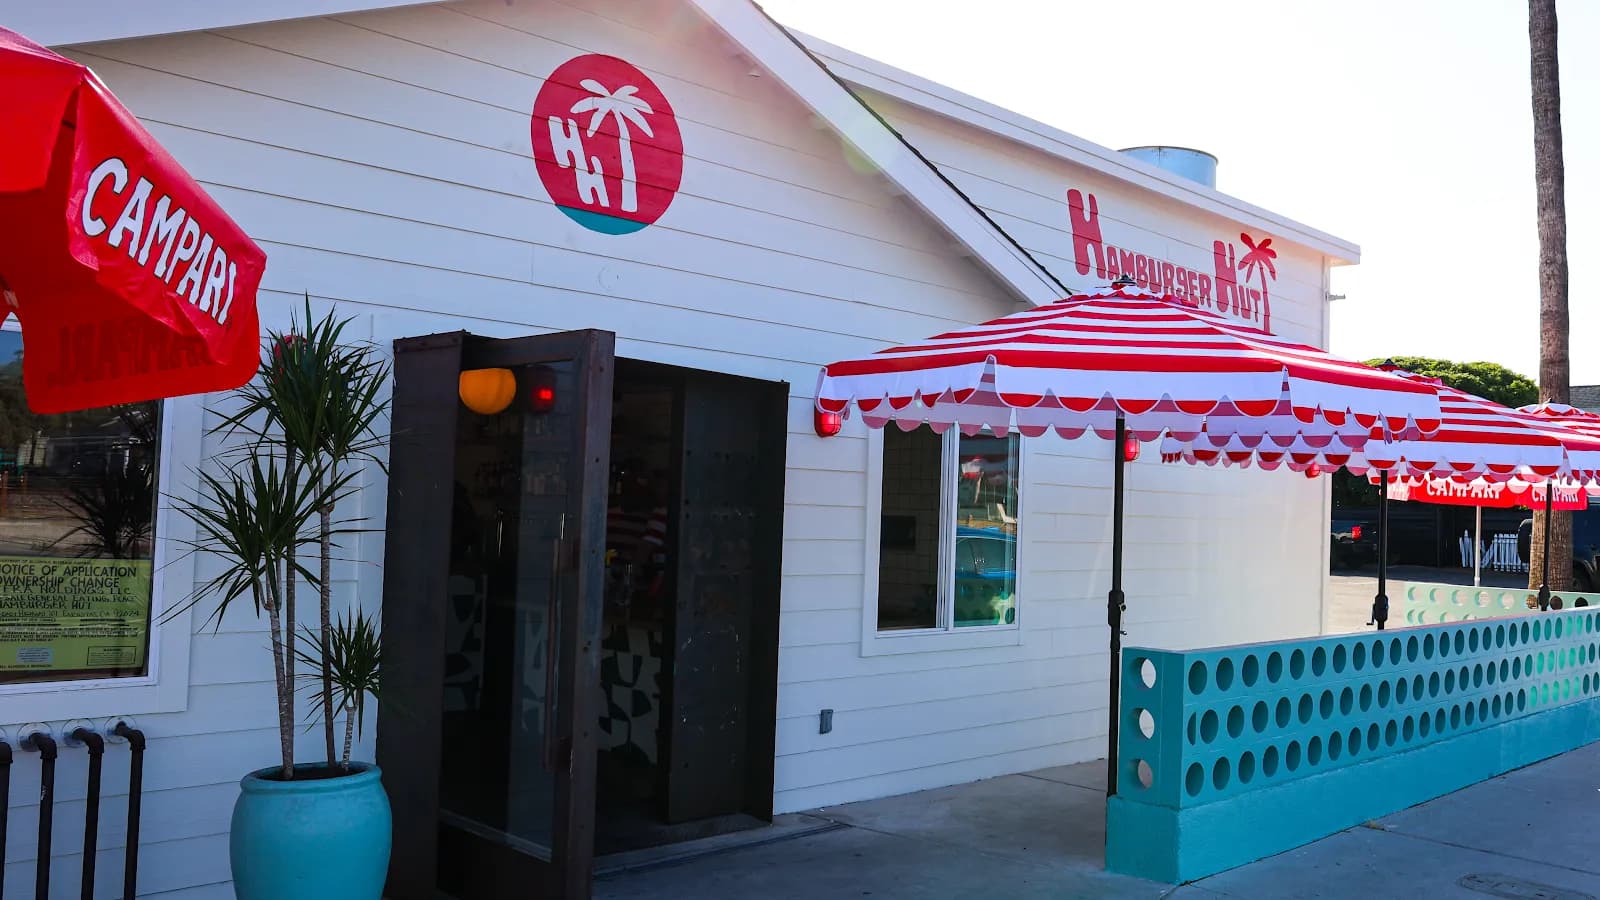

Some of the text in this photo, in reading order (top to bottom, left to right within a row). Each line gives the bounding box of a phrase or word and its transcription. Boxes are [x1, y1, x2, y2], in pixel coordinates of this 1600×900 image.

[82, 157, 237, 325] CAMPARI
[1213, 240, 1261, 322] HUT
[0, 564, 136, 577] OTICE OF APPLICATION
[70, 577, 120, 588] CHANGE
[0, 600, 67, 609] AMBURGER
